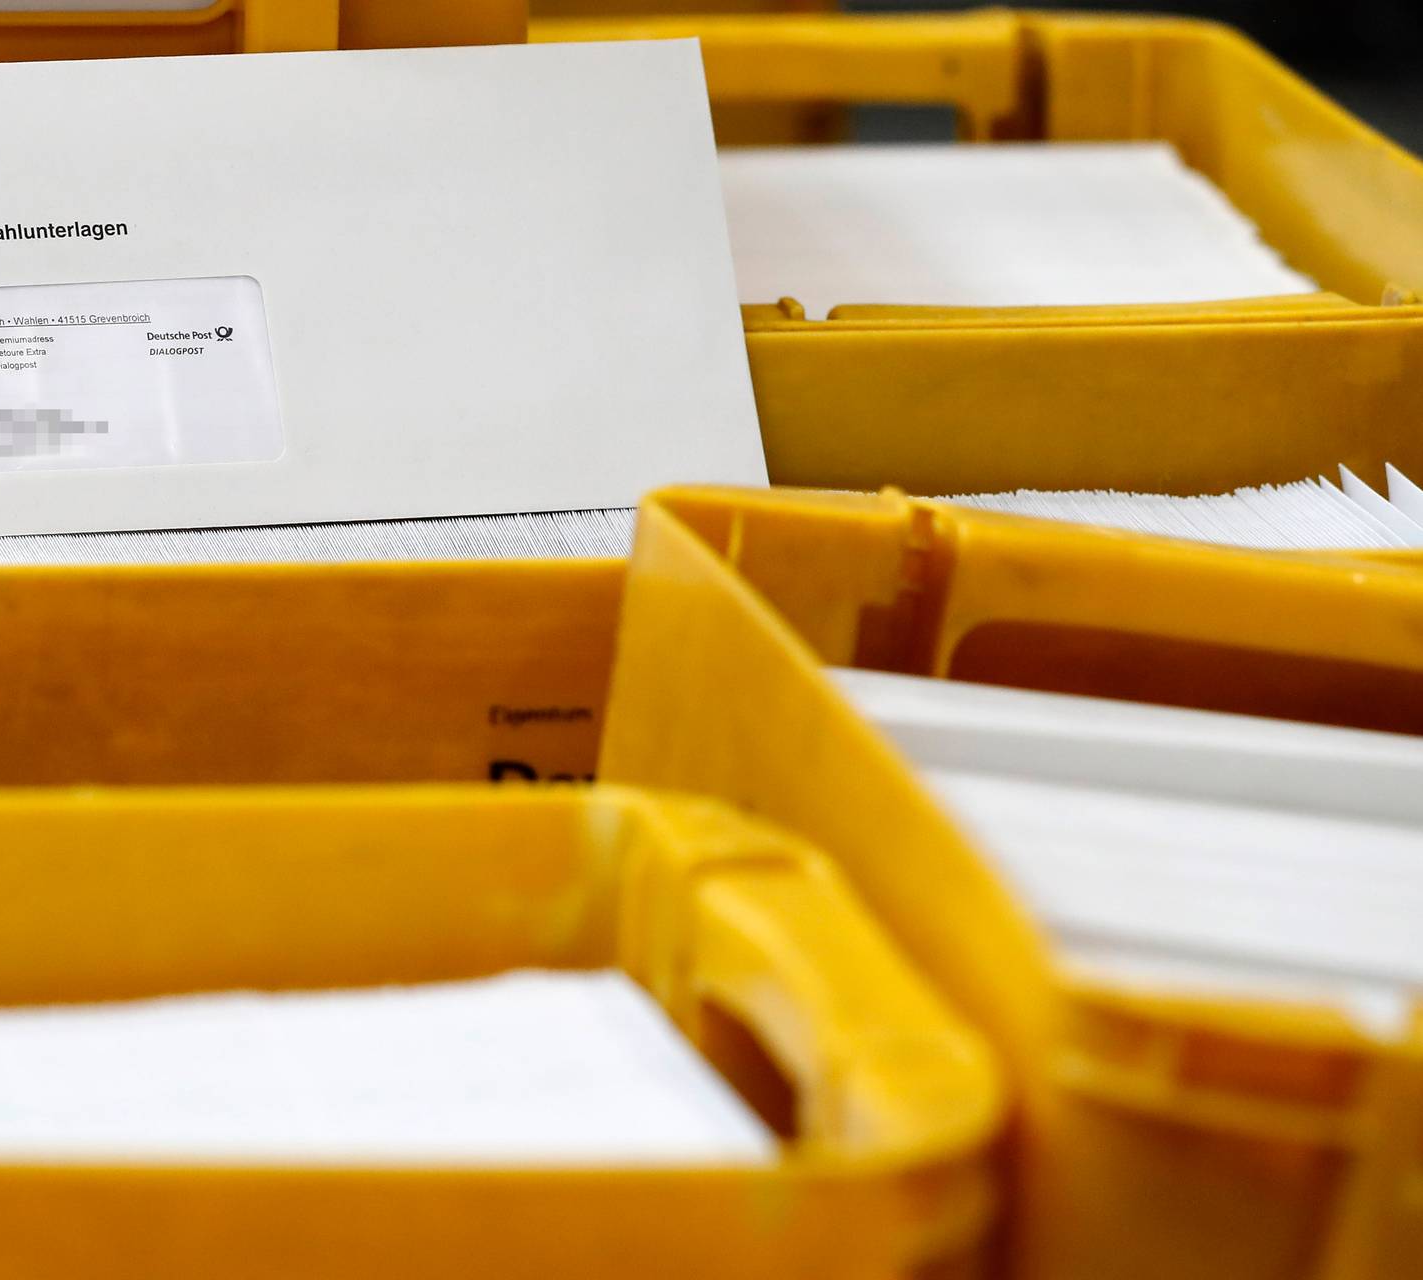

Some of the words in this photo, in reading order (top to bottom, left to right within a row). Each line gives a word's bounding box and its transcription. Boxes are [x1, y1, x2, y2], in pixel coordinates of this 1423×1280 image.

[13, 316, 49, 326] Wahlen
[57, 315, 87, 325] 41515
[89, 313, 151, 324] Grevenbroich
[147, 332, 190, 341] Deutsche
[192, 331, 212, 340] Post
[26, 348, 46, 356] Extra
[149, 347, 204, 356] DIALOGPOST
